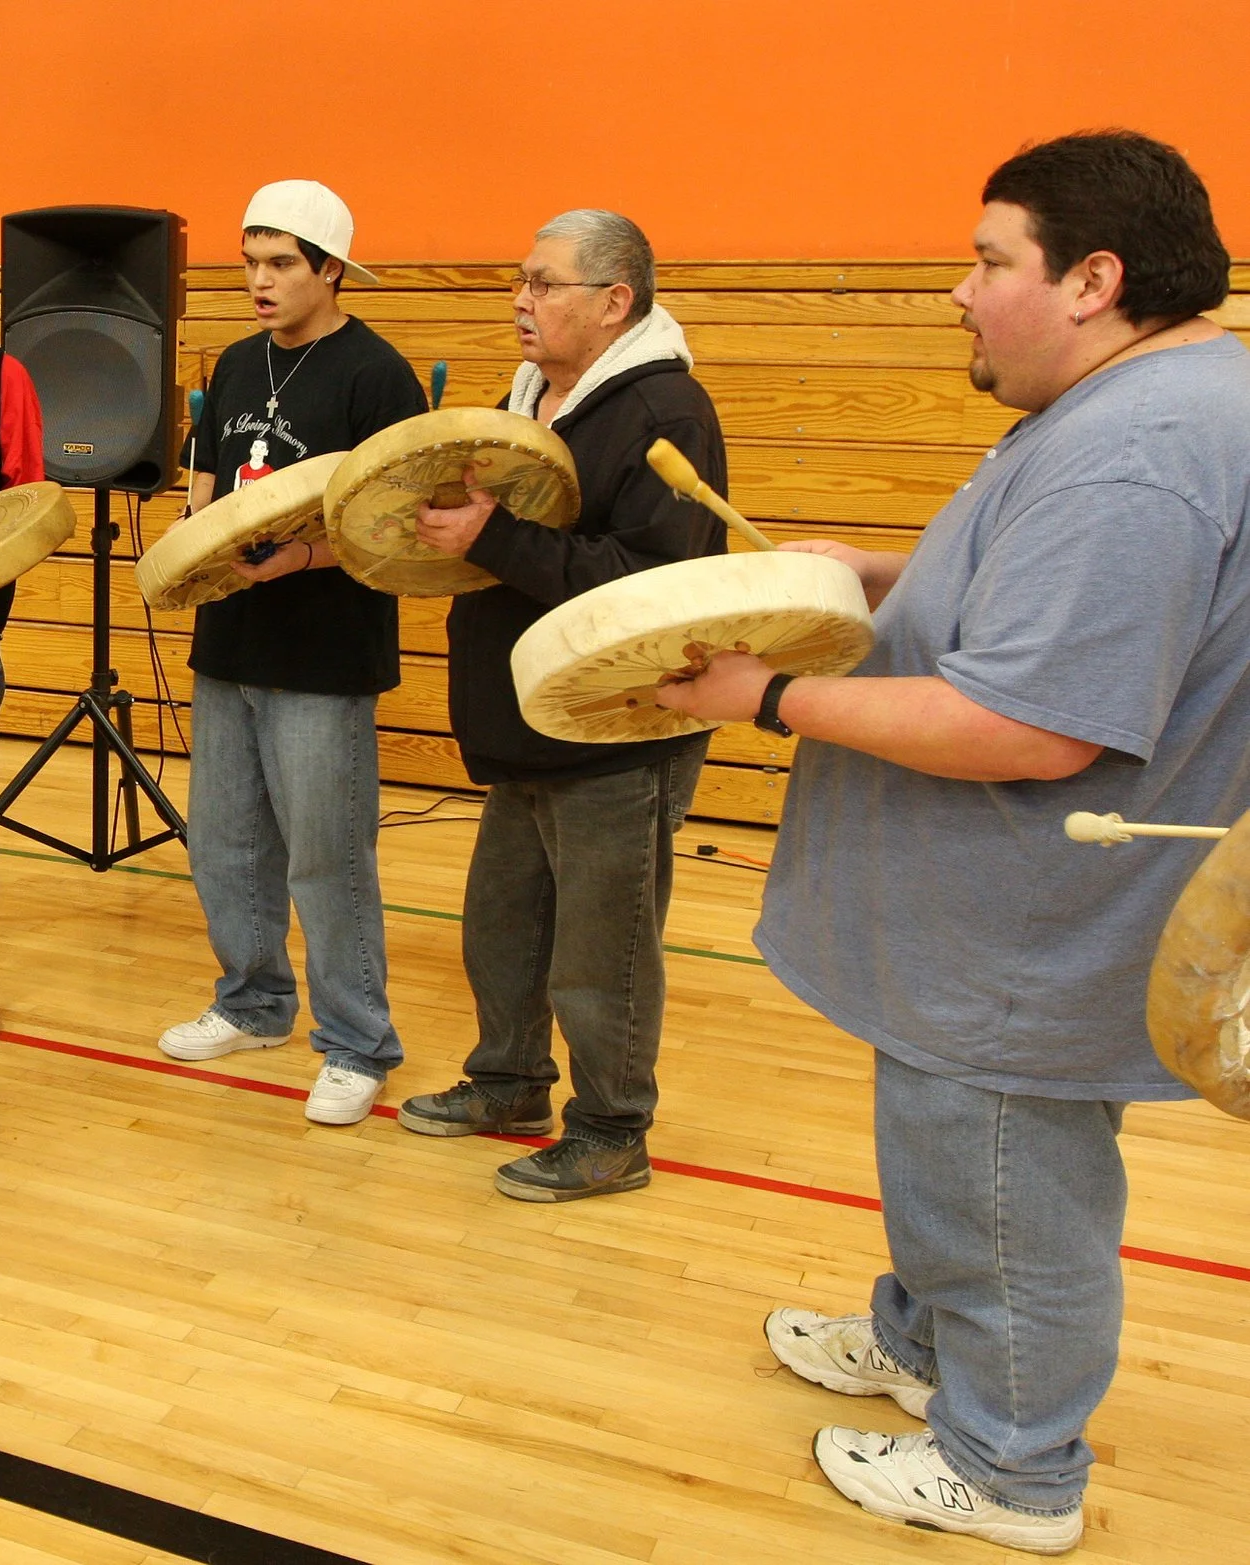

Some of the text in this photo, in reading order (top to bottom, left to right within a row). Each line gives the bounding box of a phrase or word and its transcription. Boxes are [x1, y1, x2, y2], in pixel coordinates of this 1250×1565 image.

[220, 412, 308, 458] In Loving Memory
[870, 1345, 900, 1375] N
[938, 1476, 975, 1512] N
